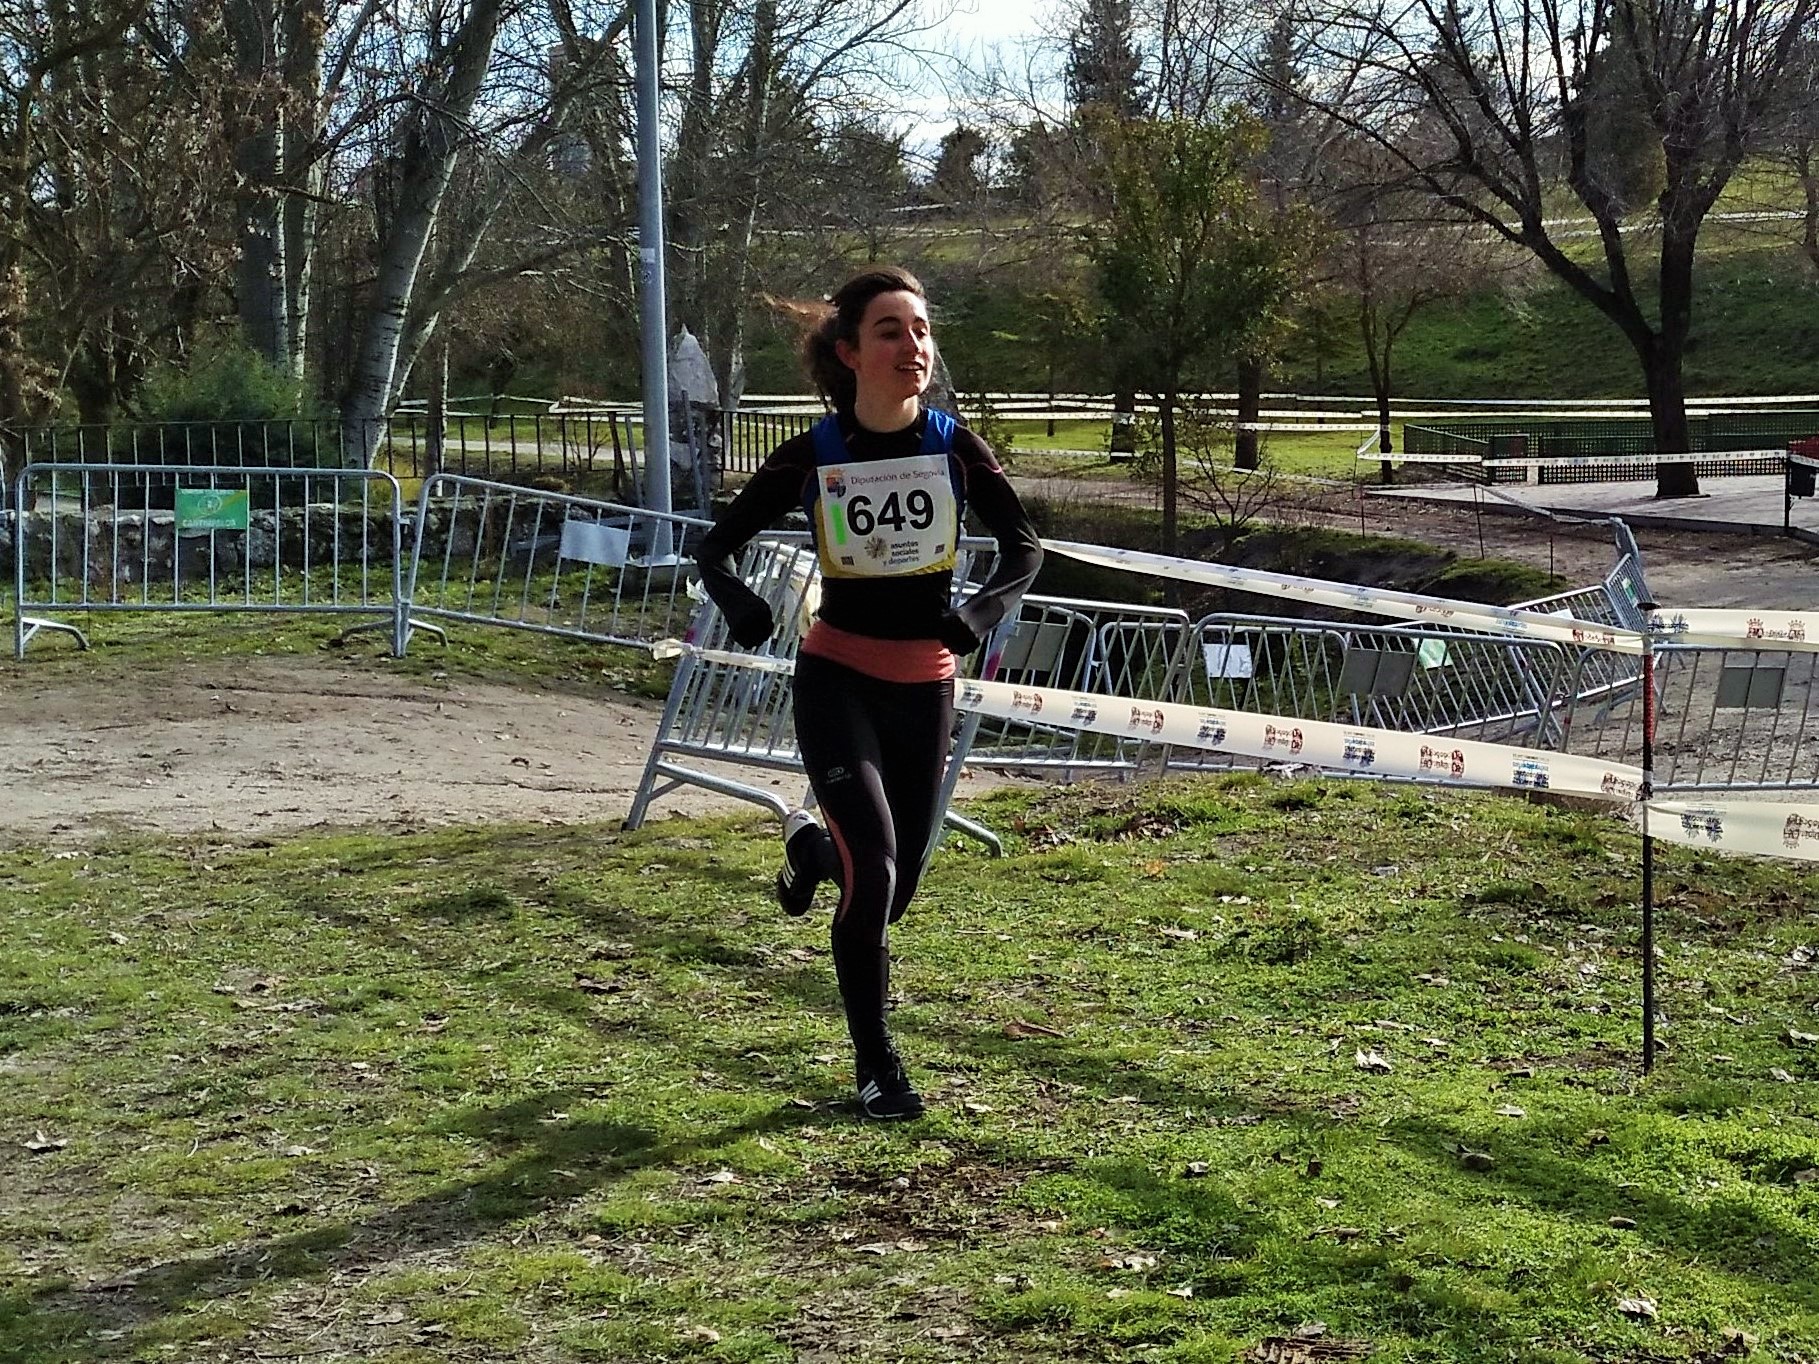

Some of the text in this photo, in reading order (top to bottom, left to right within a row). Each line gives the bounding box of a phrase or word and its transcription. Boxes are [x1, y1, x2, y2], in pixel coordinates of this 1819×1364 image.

[850, 469, 945, 486] Diputación de Segovia
[846, 489, 934, 536] 649
[890, 540, 919, 549] asuntos
[891, 548, 919, 556] sociales
[888, 556, 920, 565] deportes
